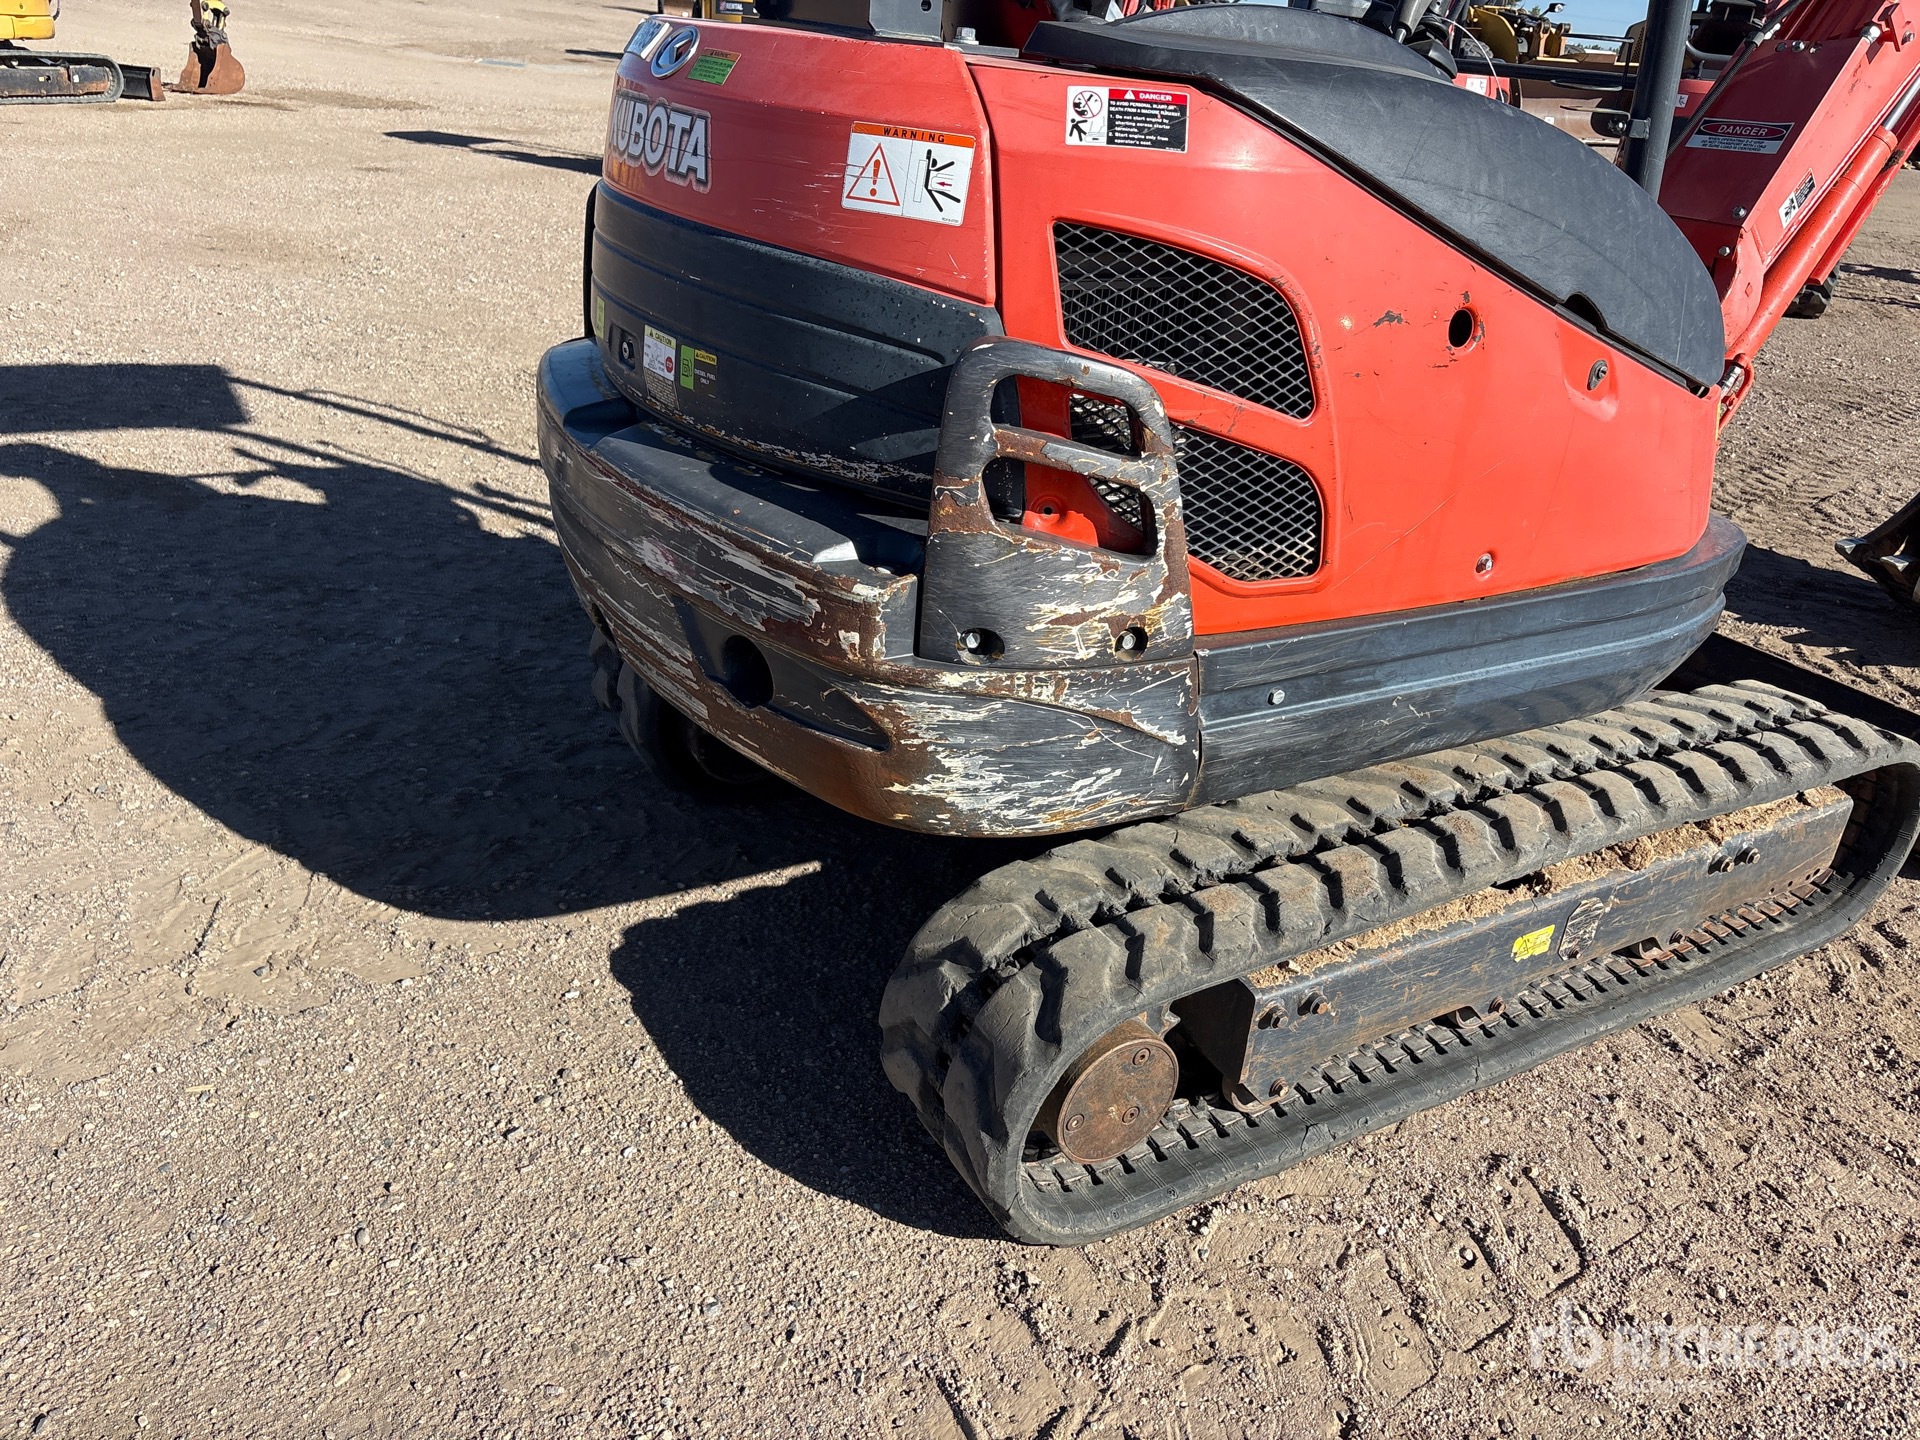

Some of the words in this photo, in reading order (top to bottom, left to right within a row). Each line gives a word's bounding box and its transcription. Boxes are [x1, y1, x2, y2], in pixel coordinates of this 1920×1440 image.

[1139, 92, 1172, 102] DANGER
[883, 127, 945, 143] WARNING
[1718, 125, 1768, 136] DANGER
[610, 96, 707, 182] KUBOTA
[654, 332, 672, 346] CAUTION
[699, 353, 716, 363] CAUTION
[694, 368, 706, 378] DIESEL
[706, 372, 716, 380] FUEL
